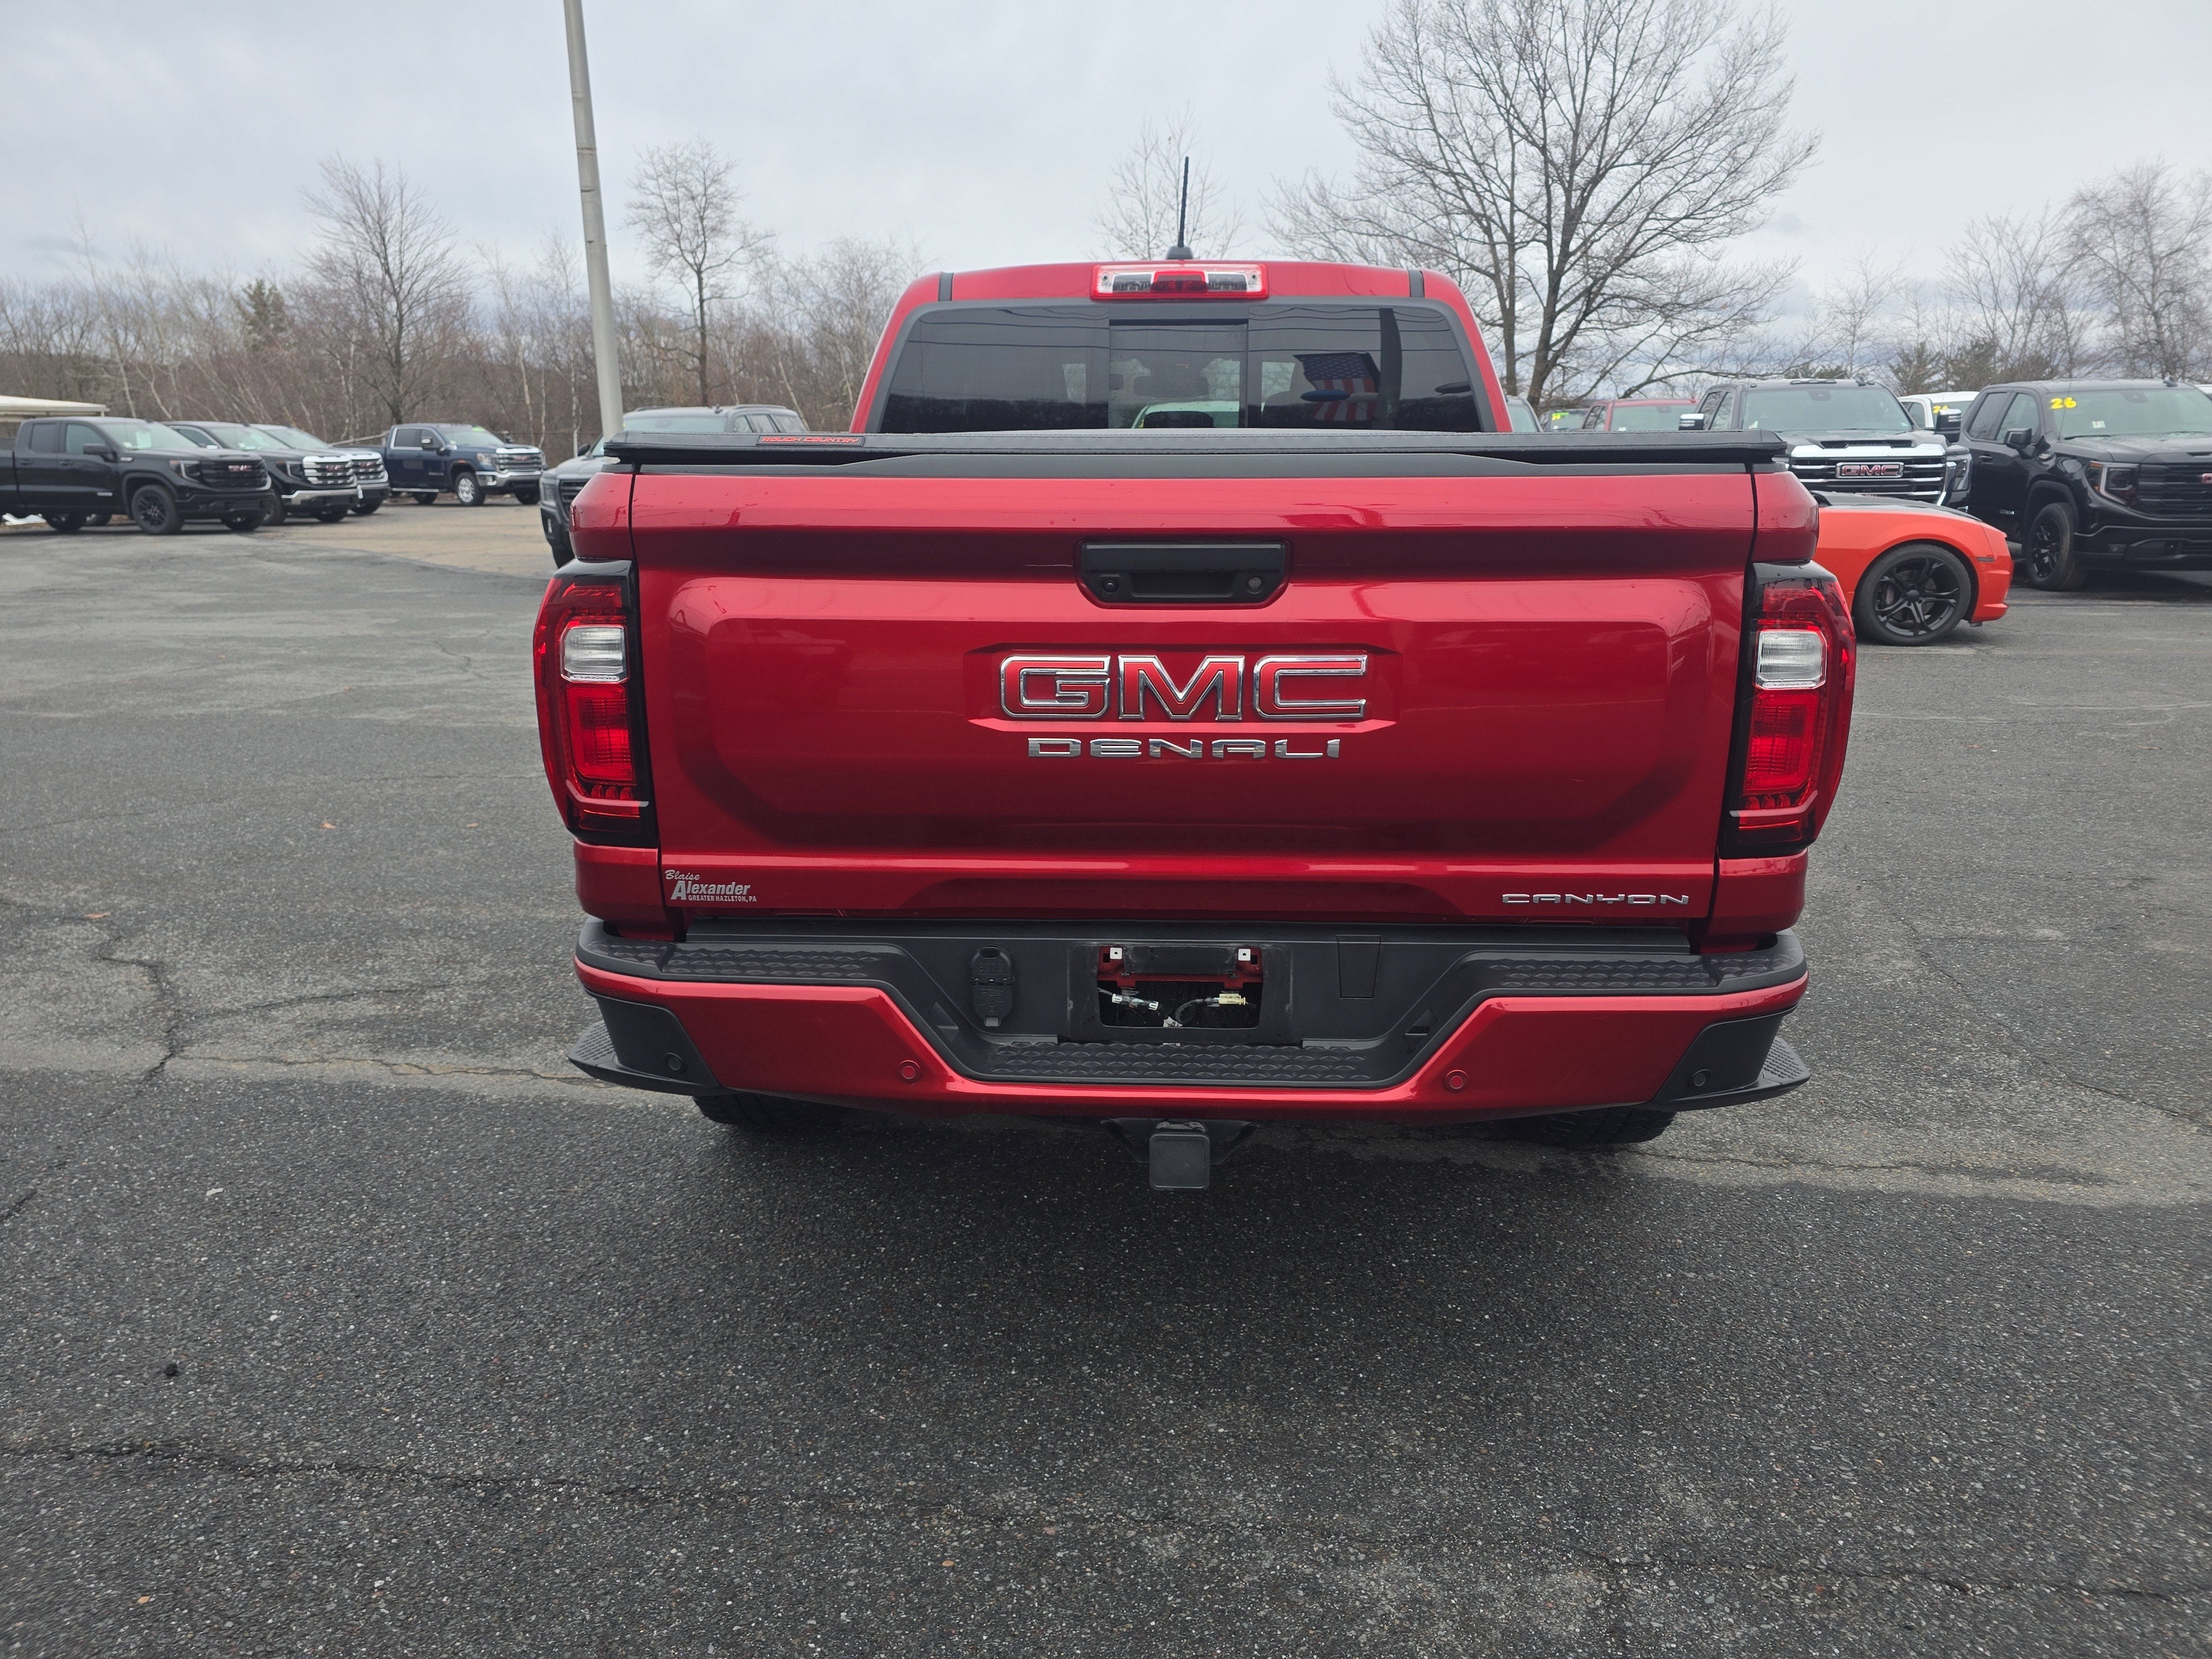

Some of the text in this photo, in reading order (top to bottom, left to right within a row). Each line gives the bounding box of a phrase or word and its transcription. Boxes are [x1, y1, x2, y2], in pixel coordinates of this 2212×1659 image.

[2050, 397, 2077, 409] 26
[1842, 465, 1899, 475] GMC
[1000, 654, 1368, 720] GMC
[1028, 737, 1340, 759] DENALI
[665, 870, 700, 880] Blaise
[671, 880, 750, 900] Alexander
[1502, 893, 1689, 905] CANYON
